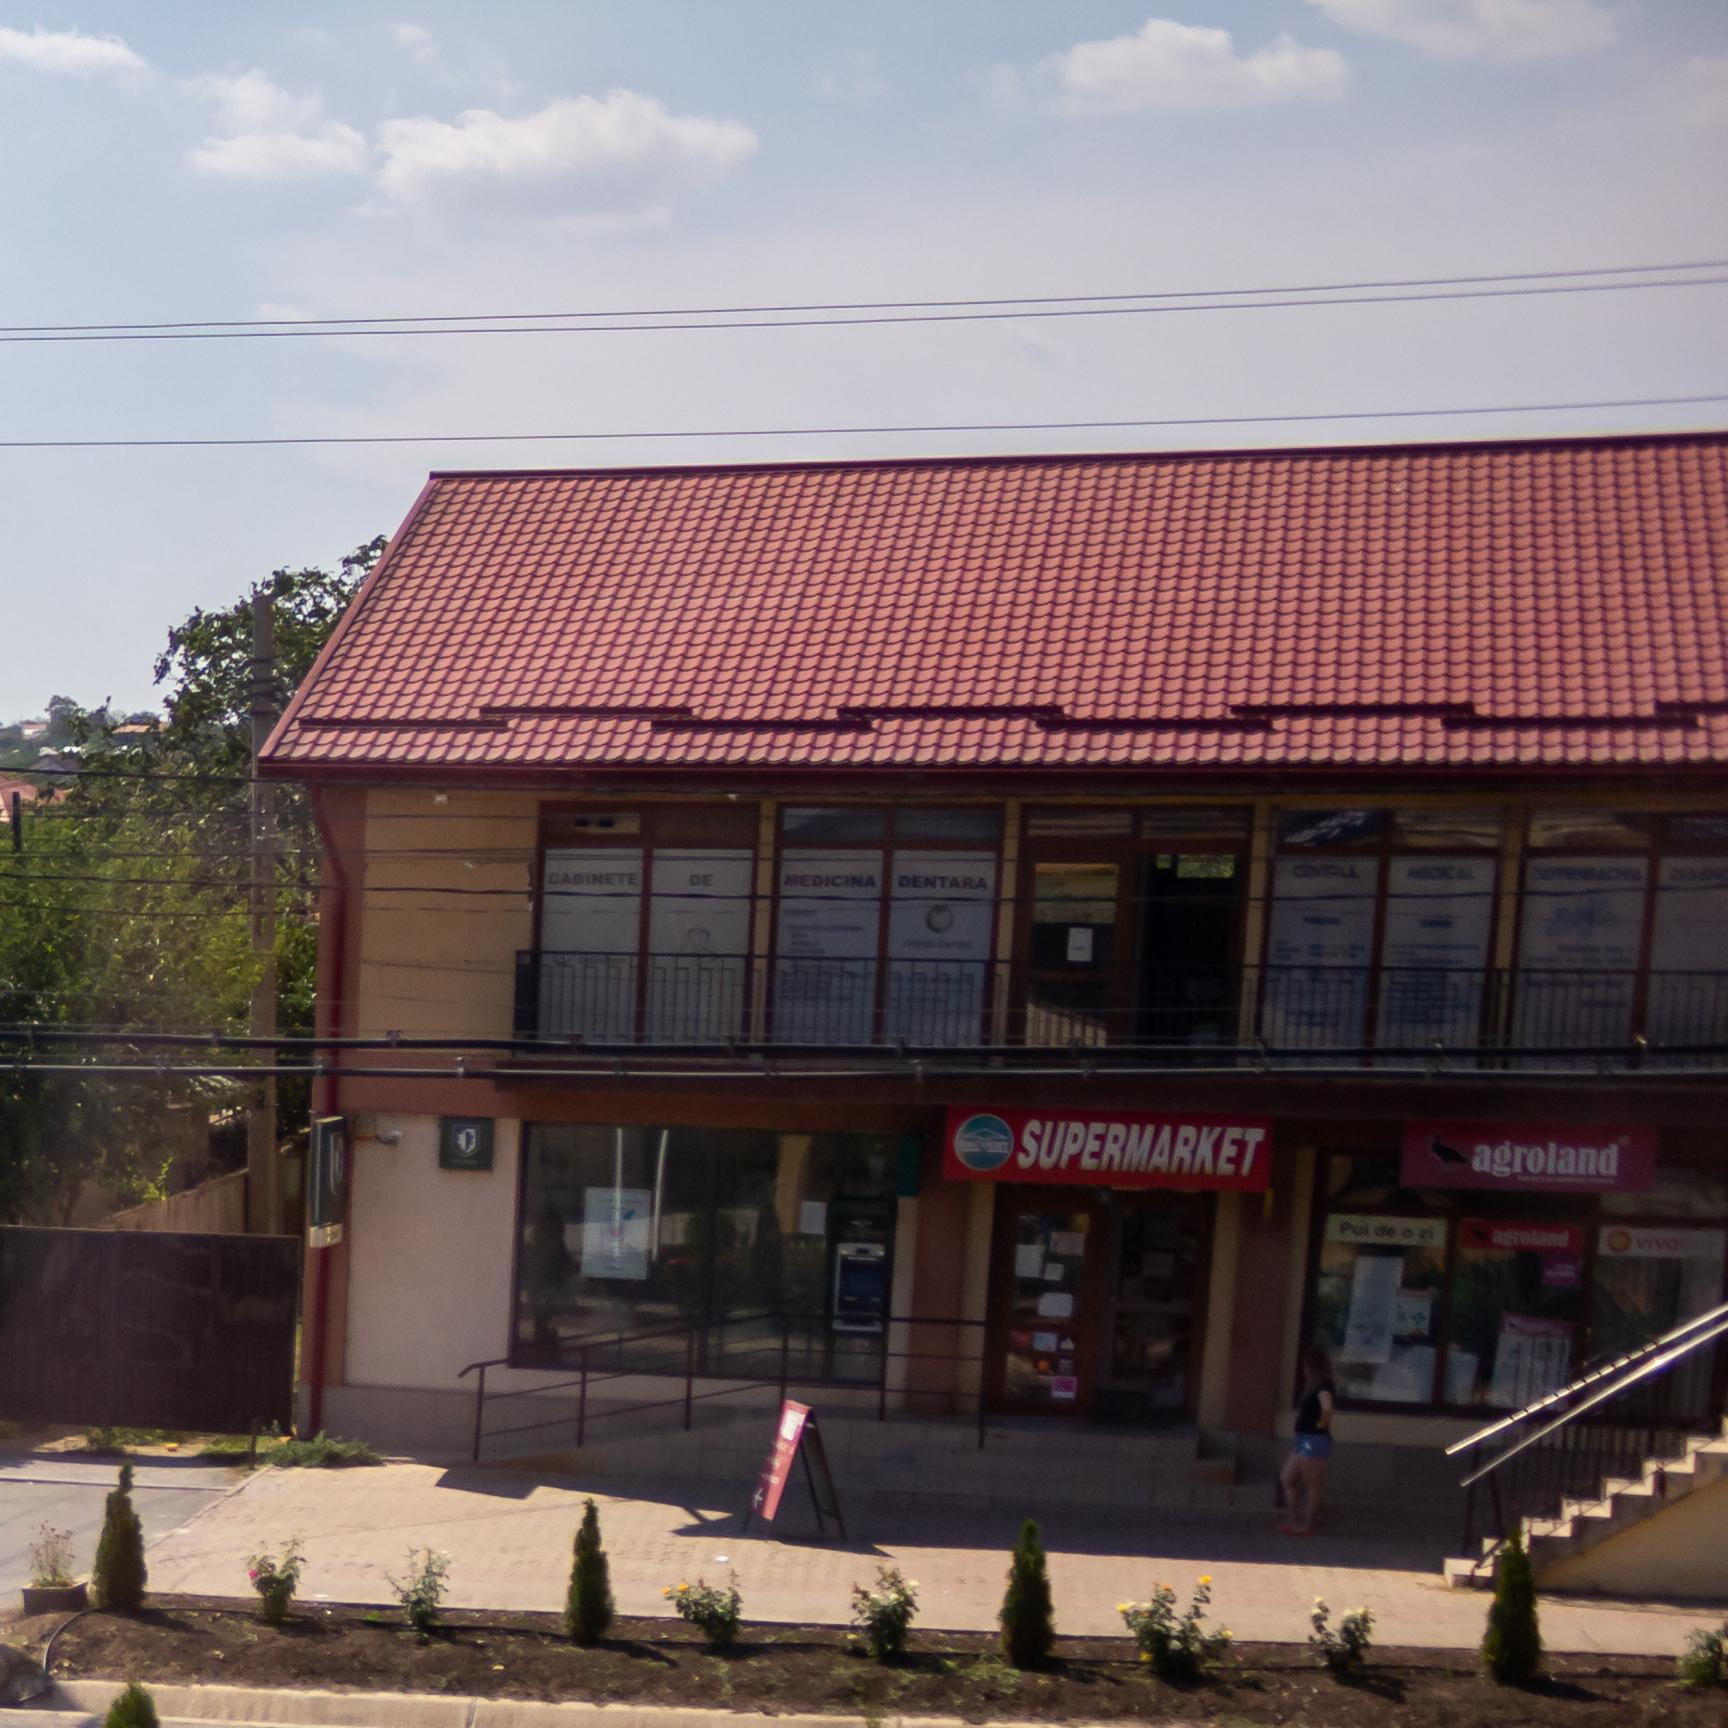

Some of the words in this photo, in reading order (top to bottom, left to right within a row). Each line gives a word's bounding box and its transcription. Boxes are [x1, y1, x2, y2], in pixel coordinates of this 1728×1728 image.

[548, 873, 638, 886] CABINETE
[688, 873, 713, 886] DE
[784, 874, 876, 888] MEDICINA
[898, 875, 988, 889] DENTARA
[1016, 1119, 1266, 1177] SUPERMARKET
[1471, 1140, 1619, 1178] agroland
[1339, 1221, 1370, 1237] Pui
[1374, 1223, 1396, 1239] de
[1401, 1227, 1413, 1240] o
[1419, 1225, 1434, 1241] zi
[1490, 1229, 1569, 1248] agroland
